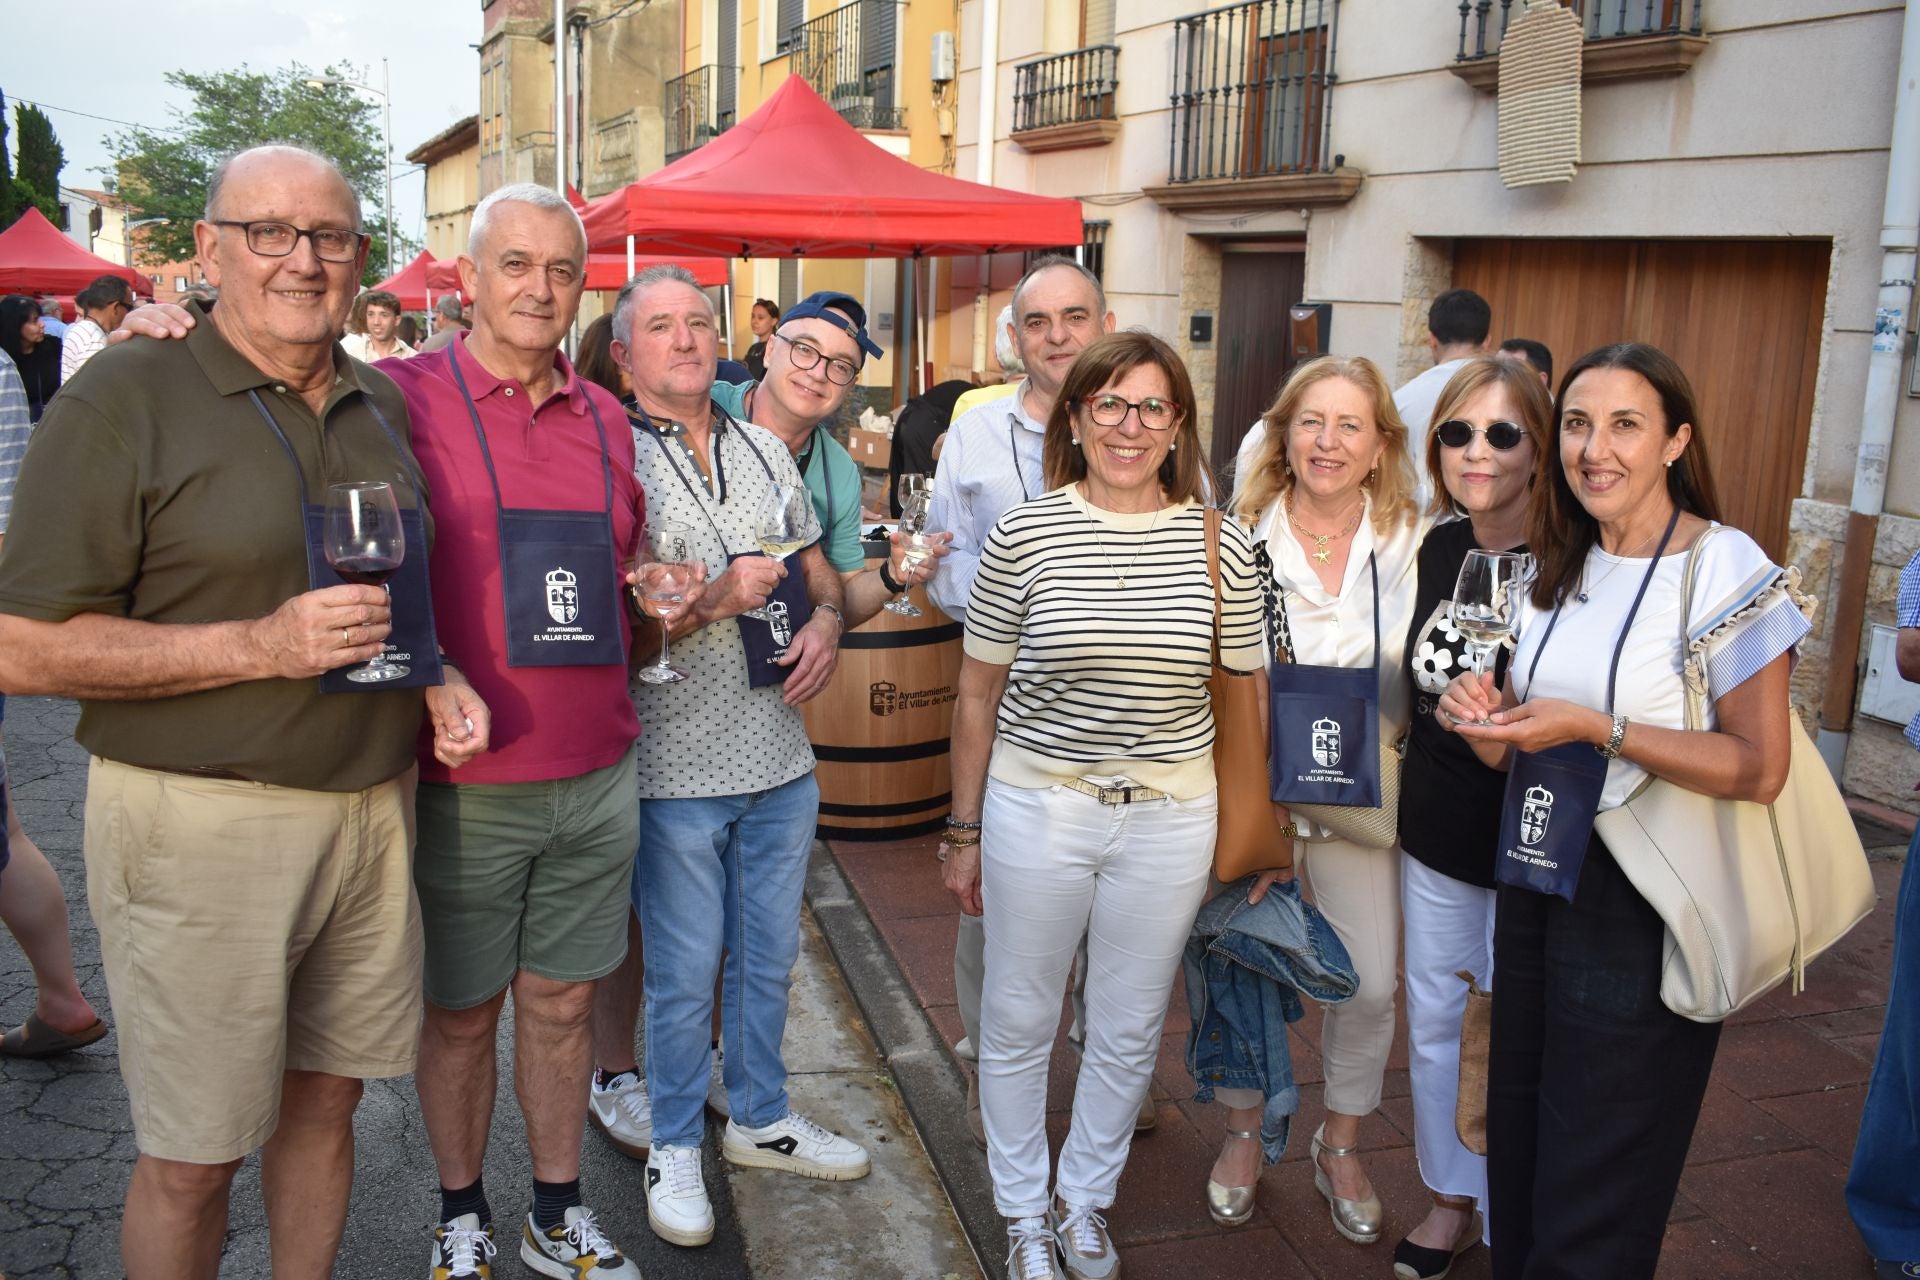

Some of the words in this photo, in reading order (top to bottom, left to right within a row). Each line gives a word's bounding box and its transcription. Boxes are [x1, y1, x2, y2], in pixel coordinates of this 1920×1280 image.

[386, 653, 411, 661] ARNEDO
[898, 686, 951, 701] Ayuntamiento
[898, 701, 908, 710] El
[910, 699, 930, 709] Villar
[931, 697, 940, 706] de
[1333, 776, 1355, 785] ARNEDO
[1521, 854, 1530, 863] DE
[1529, 857, 1558, 869] ARNEDO
